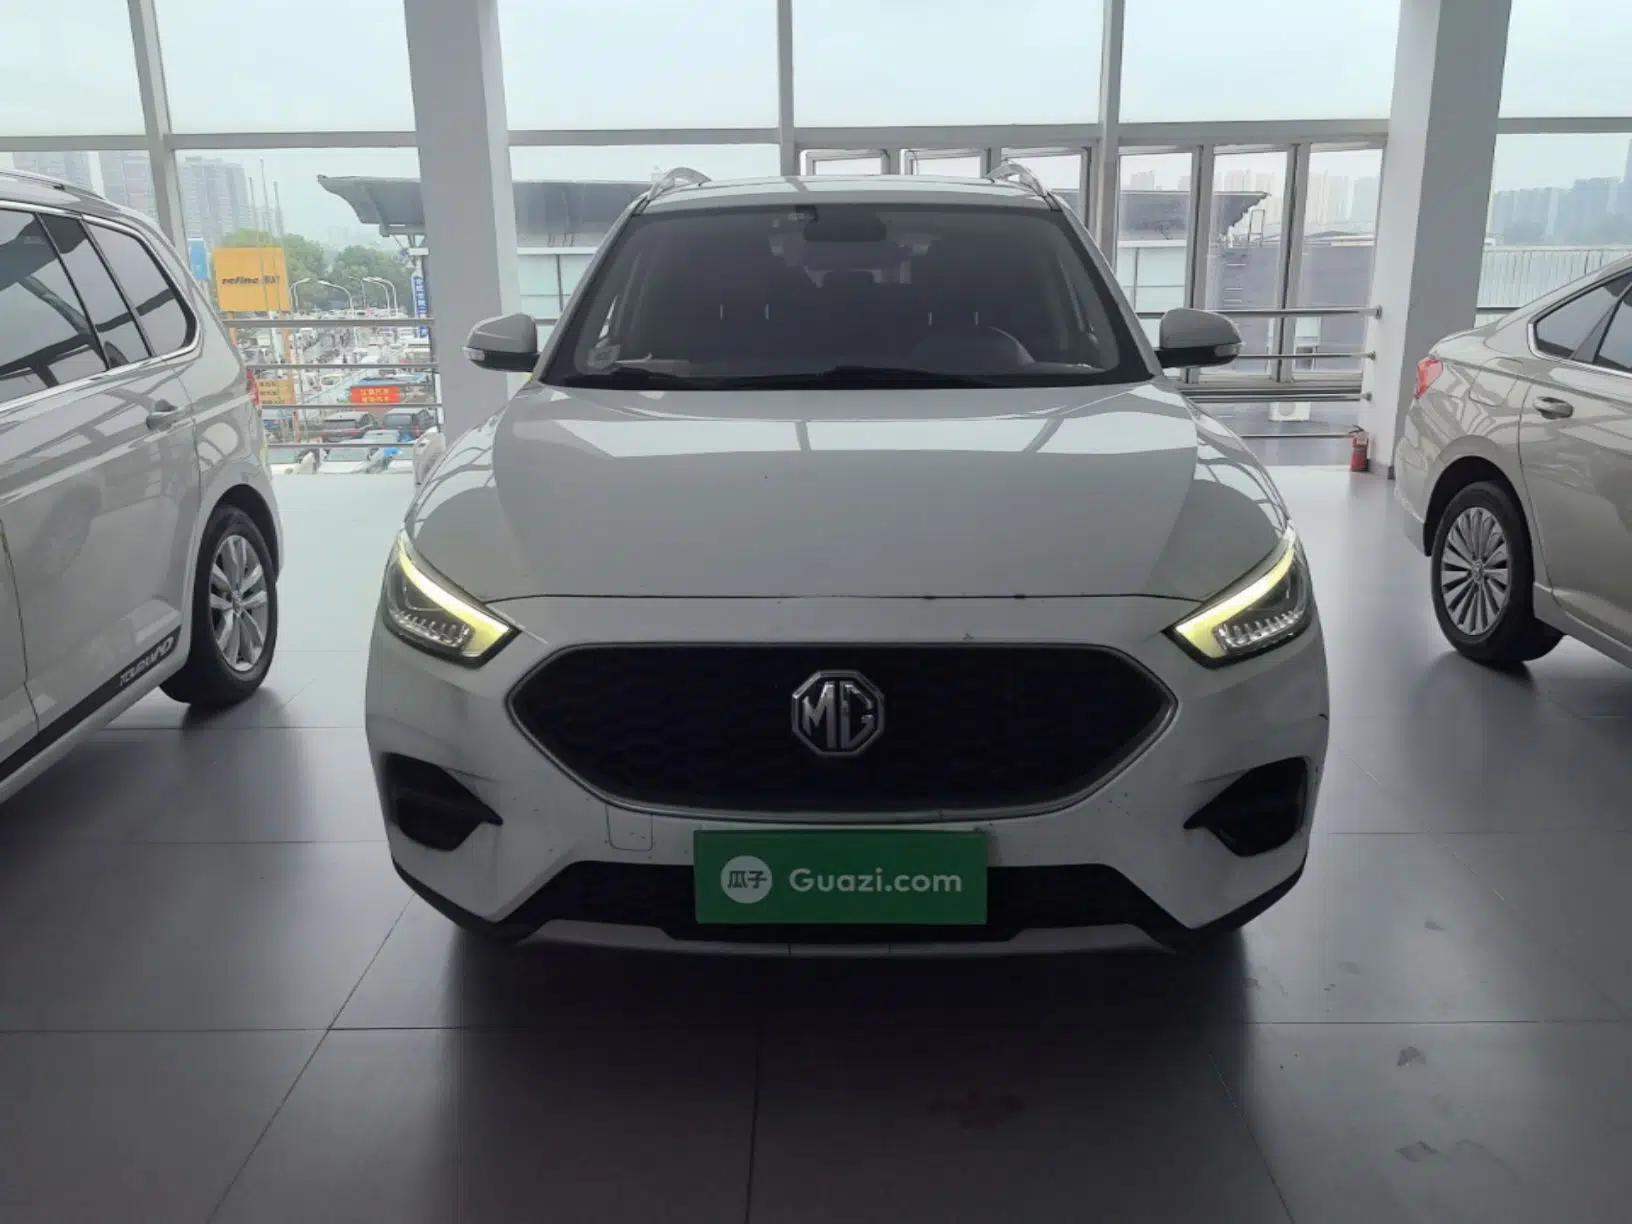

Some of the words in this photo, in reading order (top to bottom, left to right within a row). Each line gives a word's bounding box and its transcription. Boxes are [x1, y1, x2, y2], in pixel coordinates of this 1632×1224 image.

[222, 275, 259, 285] refine
[802, 681, 874, 750] MG
[727, 871, 767, 889] 瓜子
[789, 867, 962, 892] Guazi.com
